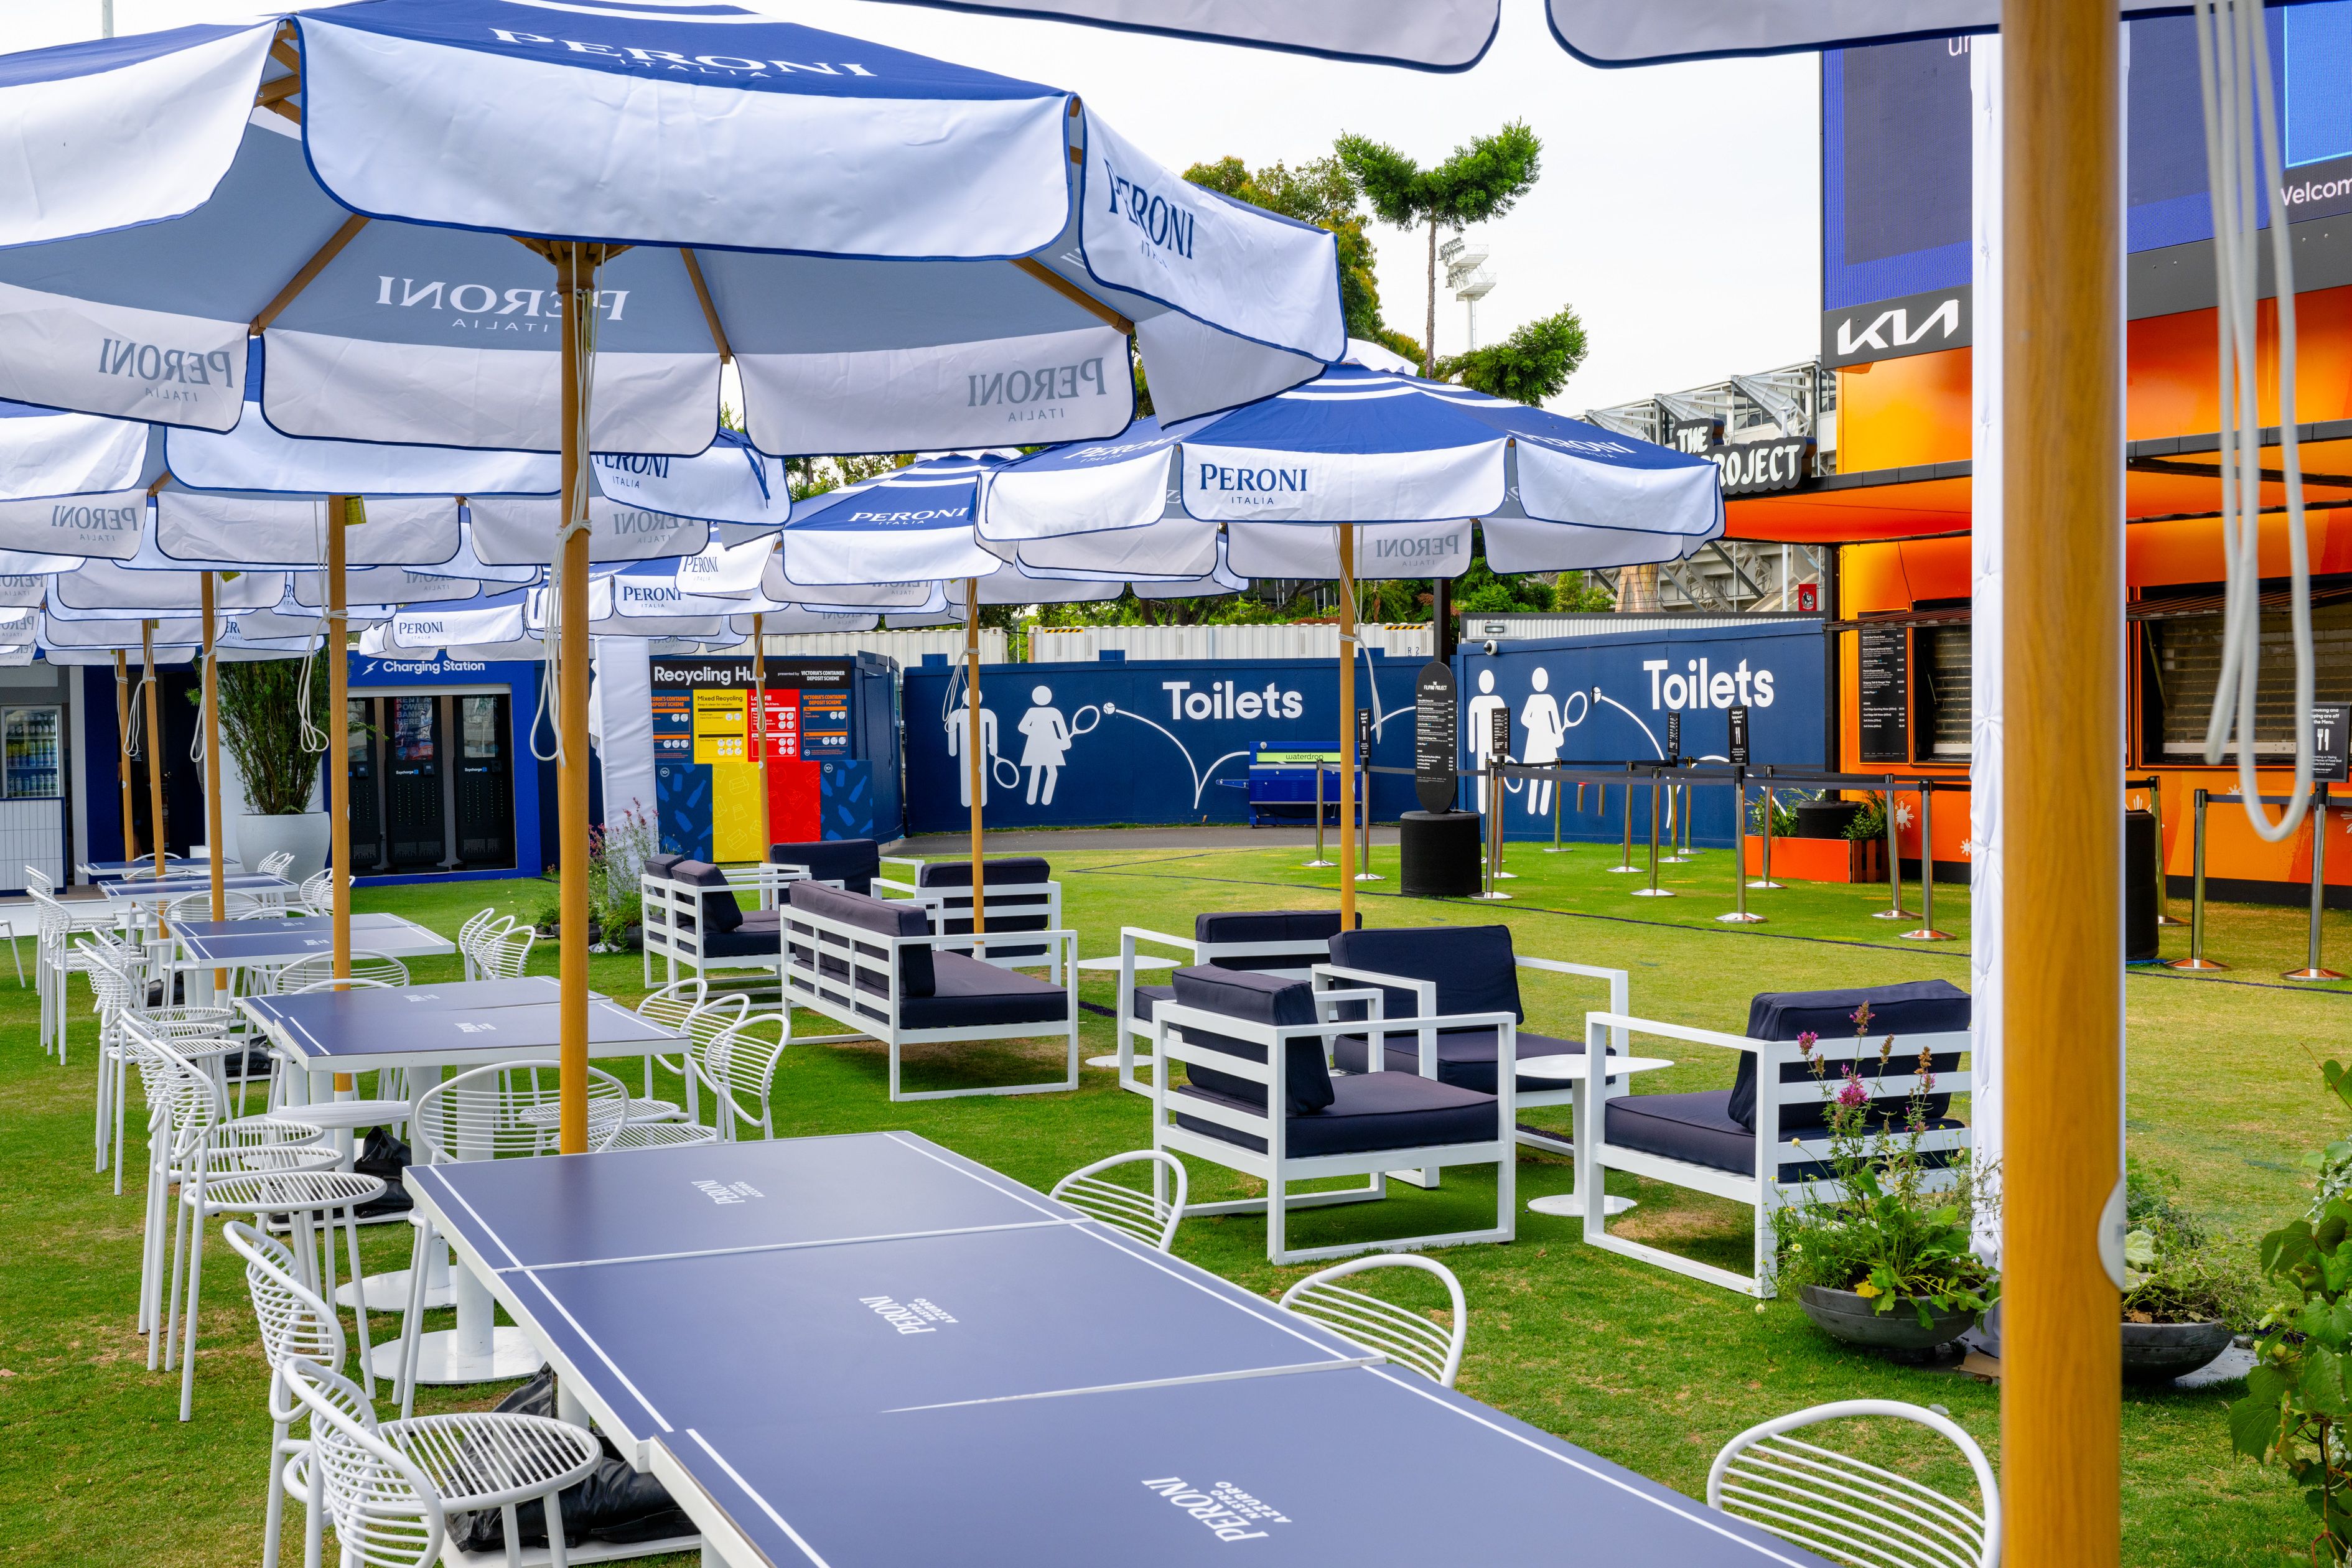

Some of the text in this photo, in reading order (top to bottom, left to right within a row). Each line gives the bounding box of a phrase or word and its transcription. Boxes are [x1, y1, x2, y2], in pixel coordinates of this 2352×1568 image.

[488, 27, 878, 77] PERONI
[620, 59, 772, 78] ITALIA
[1103, 158, 1193, 259] PERONI
[1063, 432, 1186, 459] PERONI
[1505, 429, 1637, 454] PERONI
[1677, 426, 1708, 453] THE
[1080, 454, 1122, 463] ITALIA
[1717, 444, 1800, 487] ROJECT
[612, 476, 640, 488] ITALIA
[1199, 464, 1307, 492] PERONI
[1231, 496, 1274, 505] ITALIA
[847, 507, 969, 521] PERONI
[683, 556, 719, 573] PERONI
[623, 586, 682, 601] PERONI
[399, 621, 444, 634] PERONI
[383, 660, 485, 674] Charging Station
[654, 666, 731, 686] Recycling
[1643, 658, 1775, 709] Toilets
[1162, 681, 1303, 720] Toilets
[691, 1180, 745, 1204] PERONI
[859, 1295, 937, 1335] PERONI
[907, 1303, 938, 1321] NASTRO
[913, 1298, 959, 1323] AZZURRO
[1141, 1477, 1269, 1542] PERONI
[1210, 1490, 1262, 1519] NASTRO
[1215, 1482, 1292, 1523] AZZURRO
